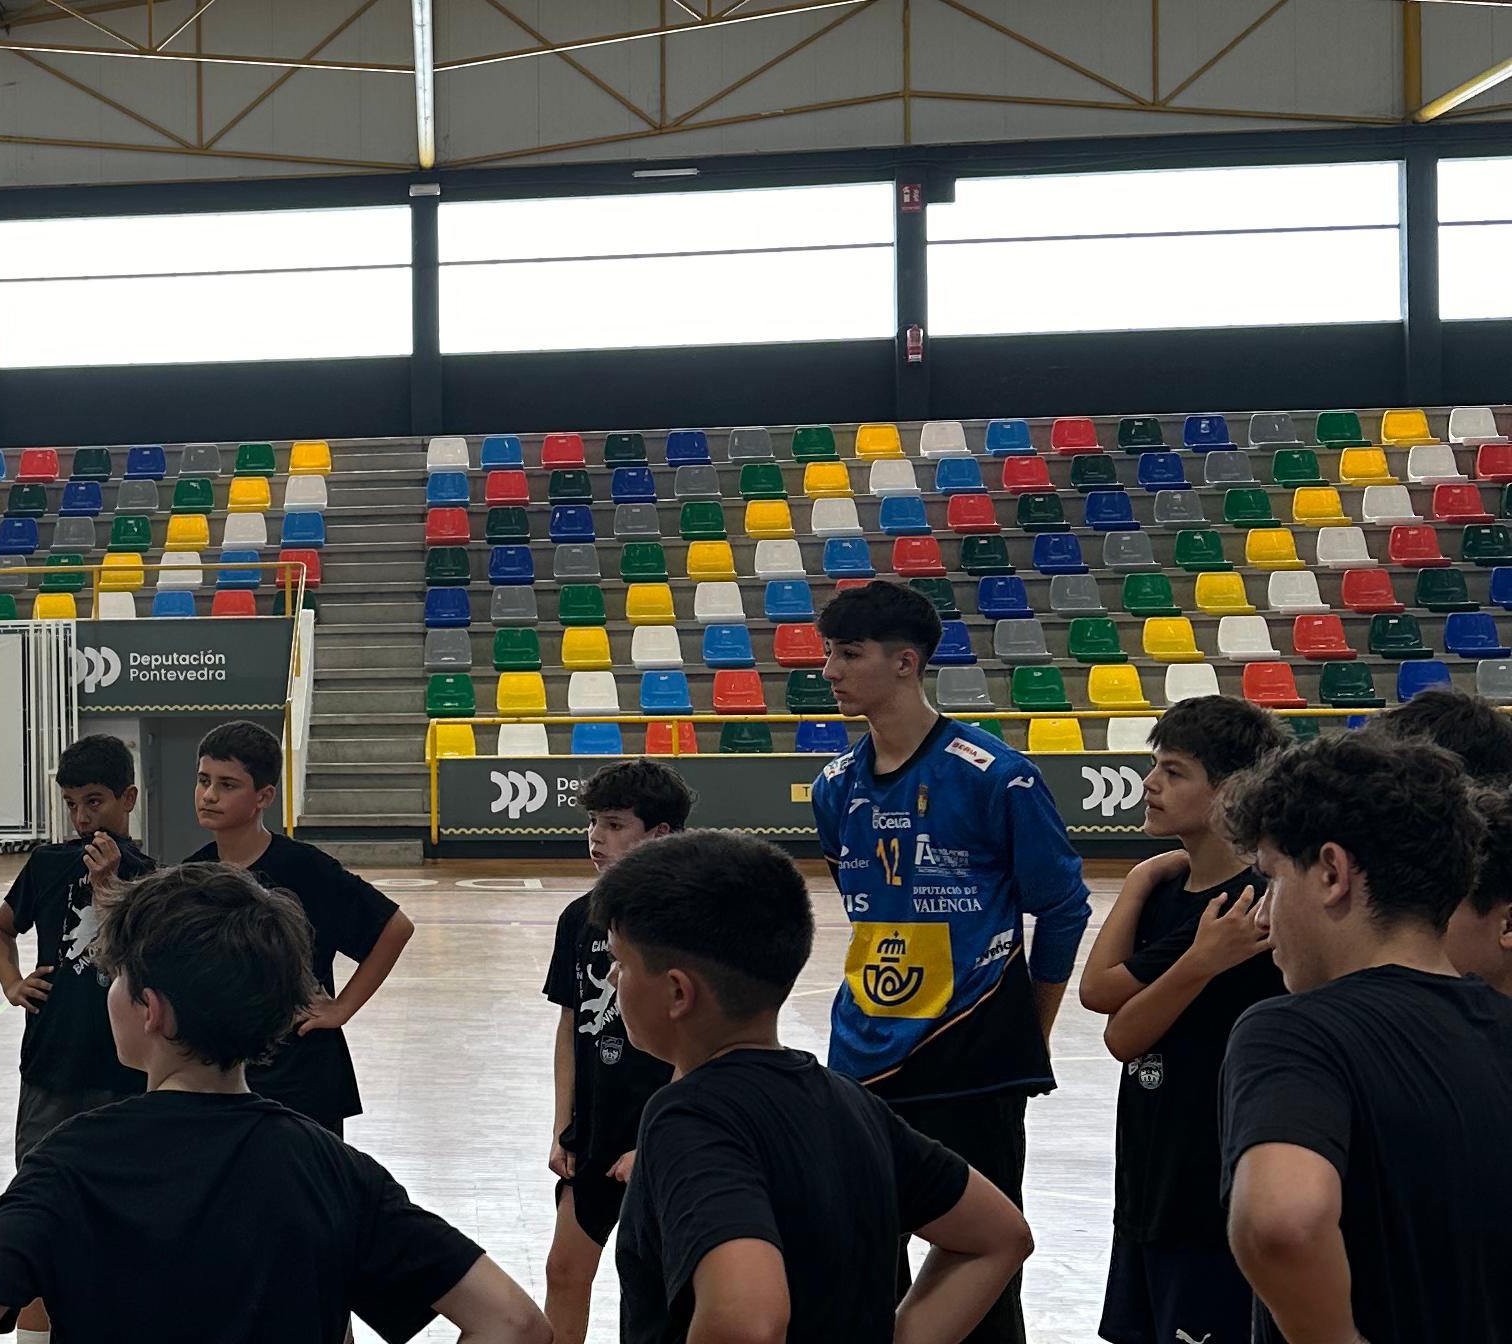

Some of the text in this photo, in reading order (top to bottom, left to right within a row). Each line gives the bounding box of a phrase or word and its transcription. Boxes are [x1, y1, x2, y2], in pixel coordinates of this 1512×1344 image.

[129, 649, 226, 669] Deputación
[129, 667, 226, 682] Pontevedra
[876, 838, 902, 885] 12
[913, 896, 983, 913] VALÈNCIA
